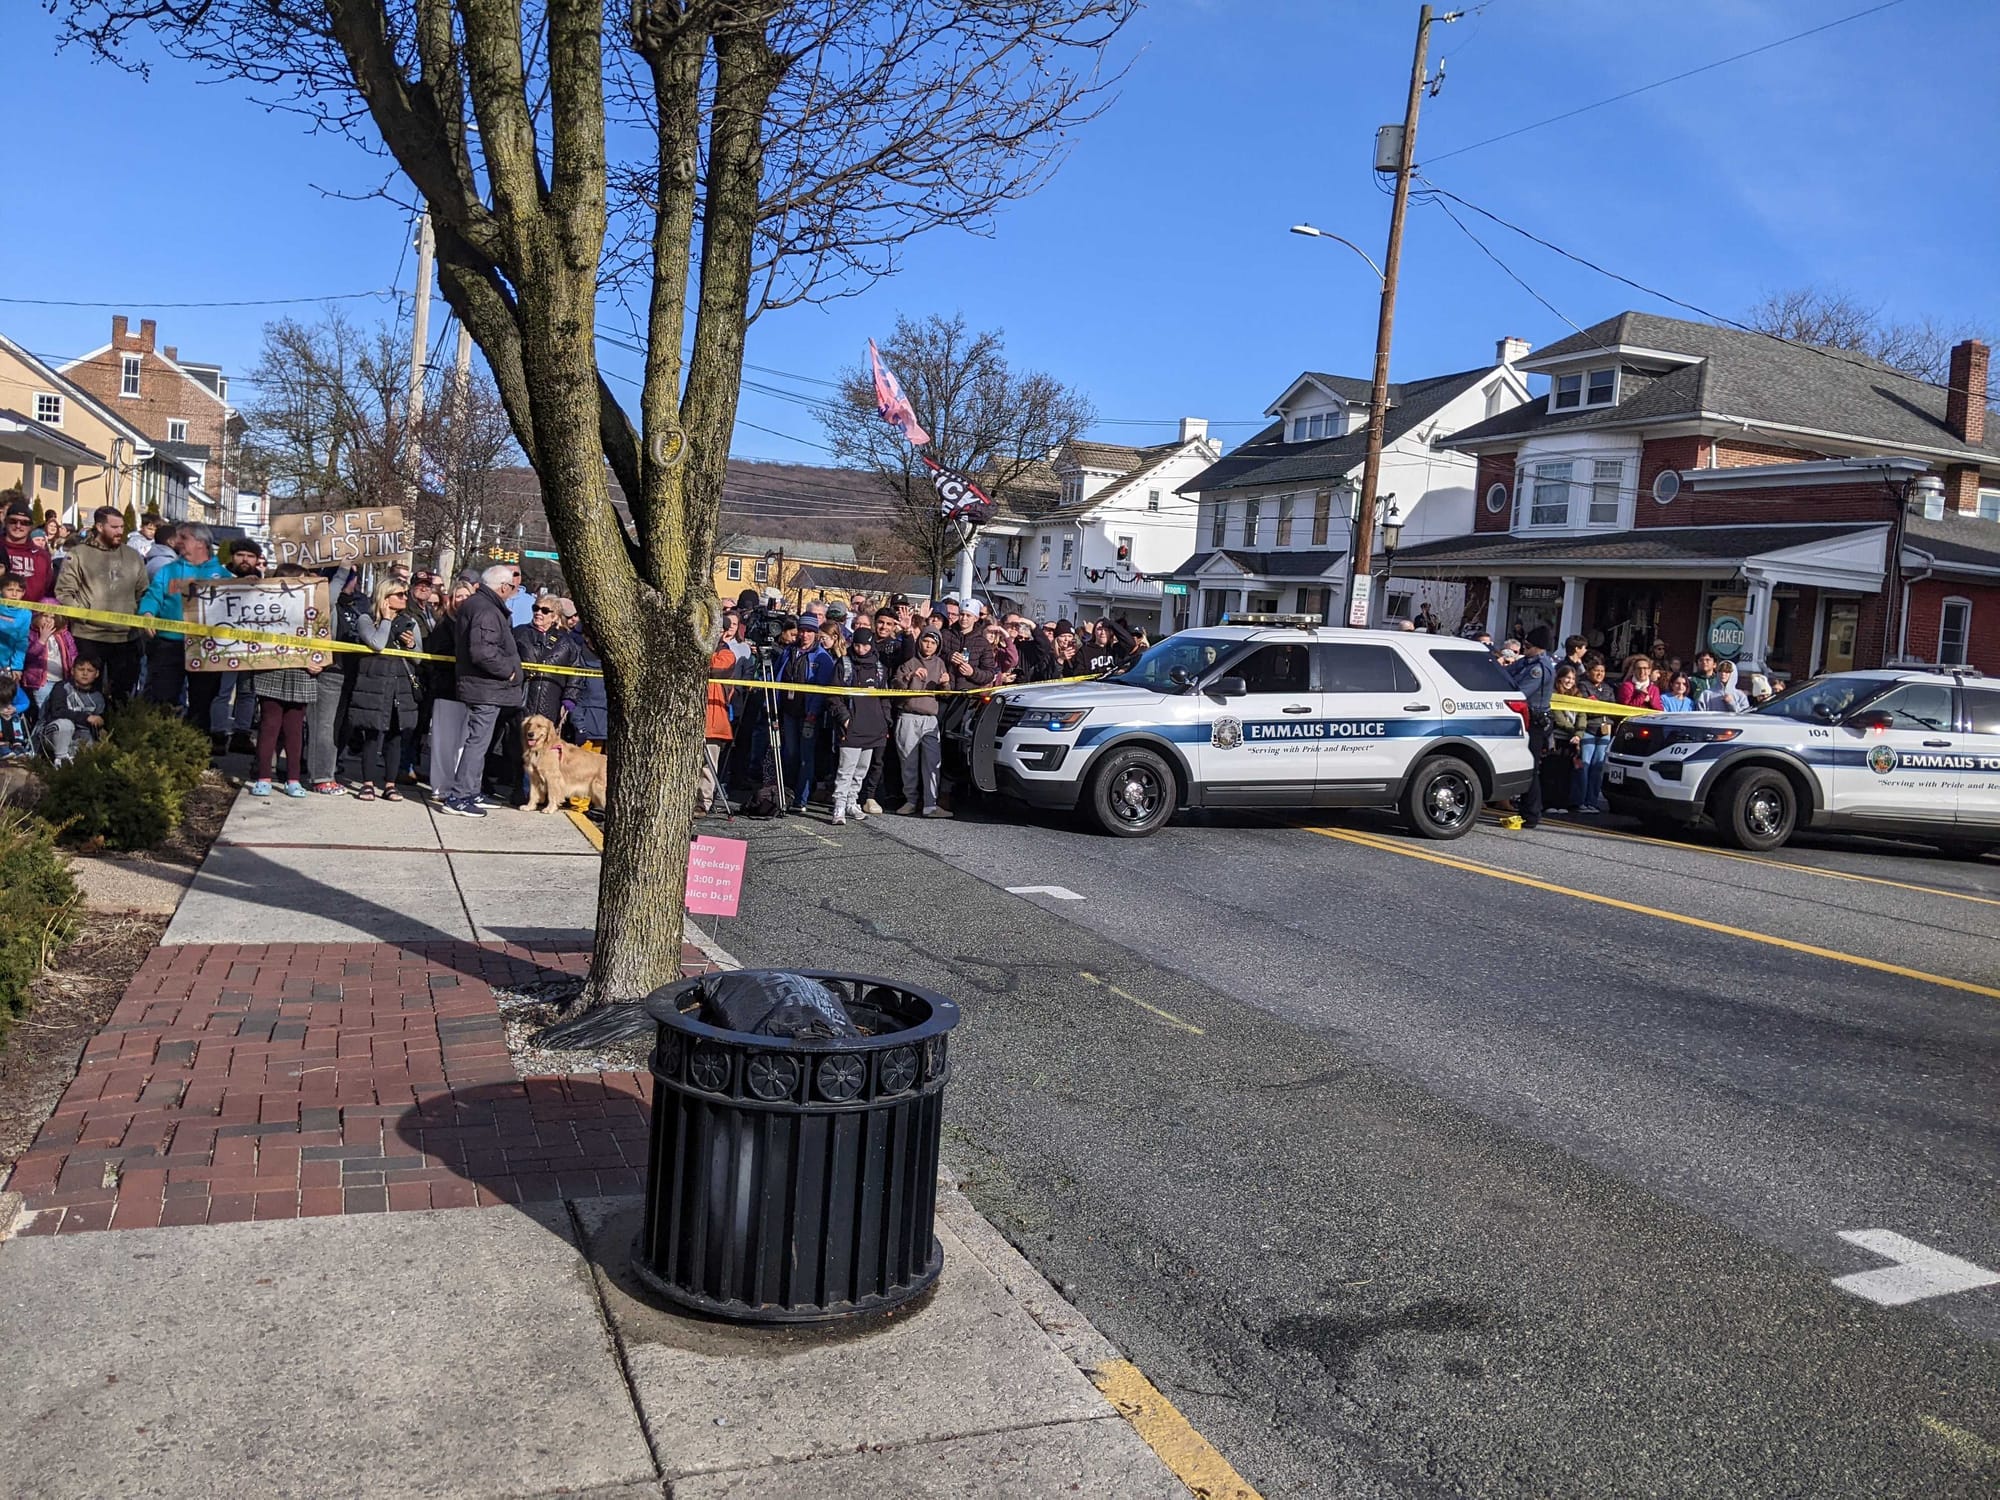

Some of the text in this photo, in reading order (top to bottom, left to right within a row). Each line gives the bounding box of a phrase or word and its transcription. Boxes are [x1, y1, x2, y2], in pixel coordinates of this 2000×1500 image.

[303, 511, 384, 536] FREE
[280, 530, 406, 566] PALESTINE
[225, 596, 282, 617] Free
[1711, 628, 1745, 645] BAKED
[1456, 701, 1505, 711] EMERGENCY 911
[1251, 724, 1324, 739] EMMAUS
[1329, 722, 1386, 736] POLICE
[1808, 729, 1829, 738] 104
[1283, 745, 1300, 754] with
[1302, 744, 1321, 753] Pride
[1324, 744, 1338, 752] and
[1670, 746, 1689, 756] 104
[1902, 754, 1975, 769] EMMAUS
[1610, 770, 1622, 779] 104
[1918, 780, 1937, 788] with
[1941, 780, 1964, 789] Pride
[1967, 781, 1984, 790] and
[693, 857, 740, 871] Weekdays
[693, 874, 714, 884] 3:00
[716, 878, 731, 887] pm
